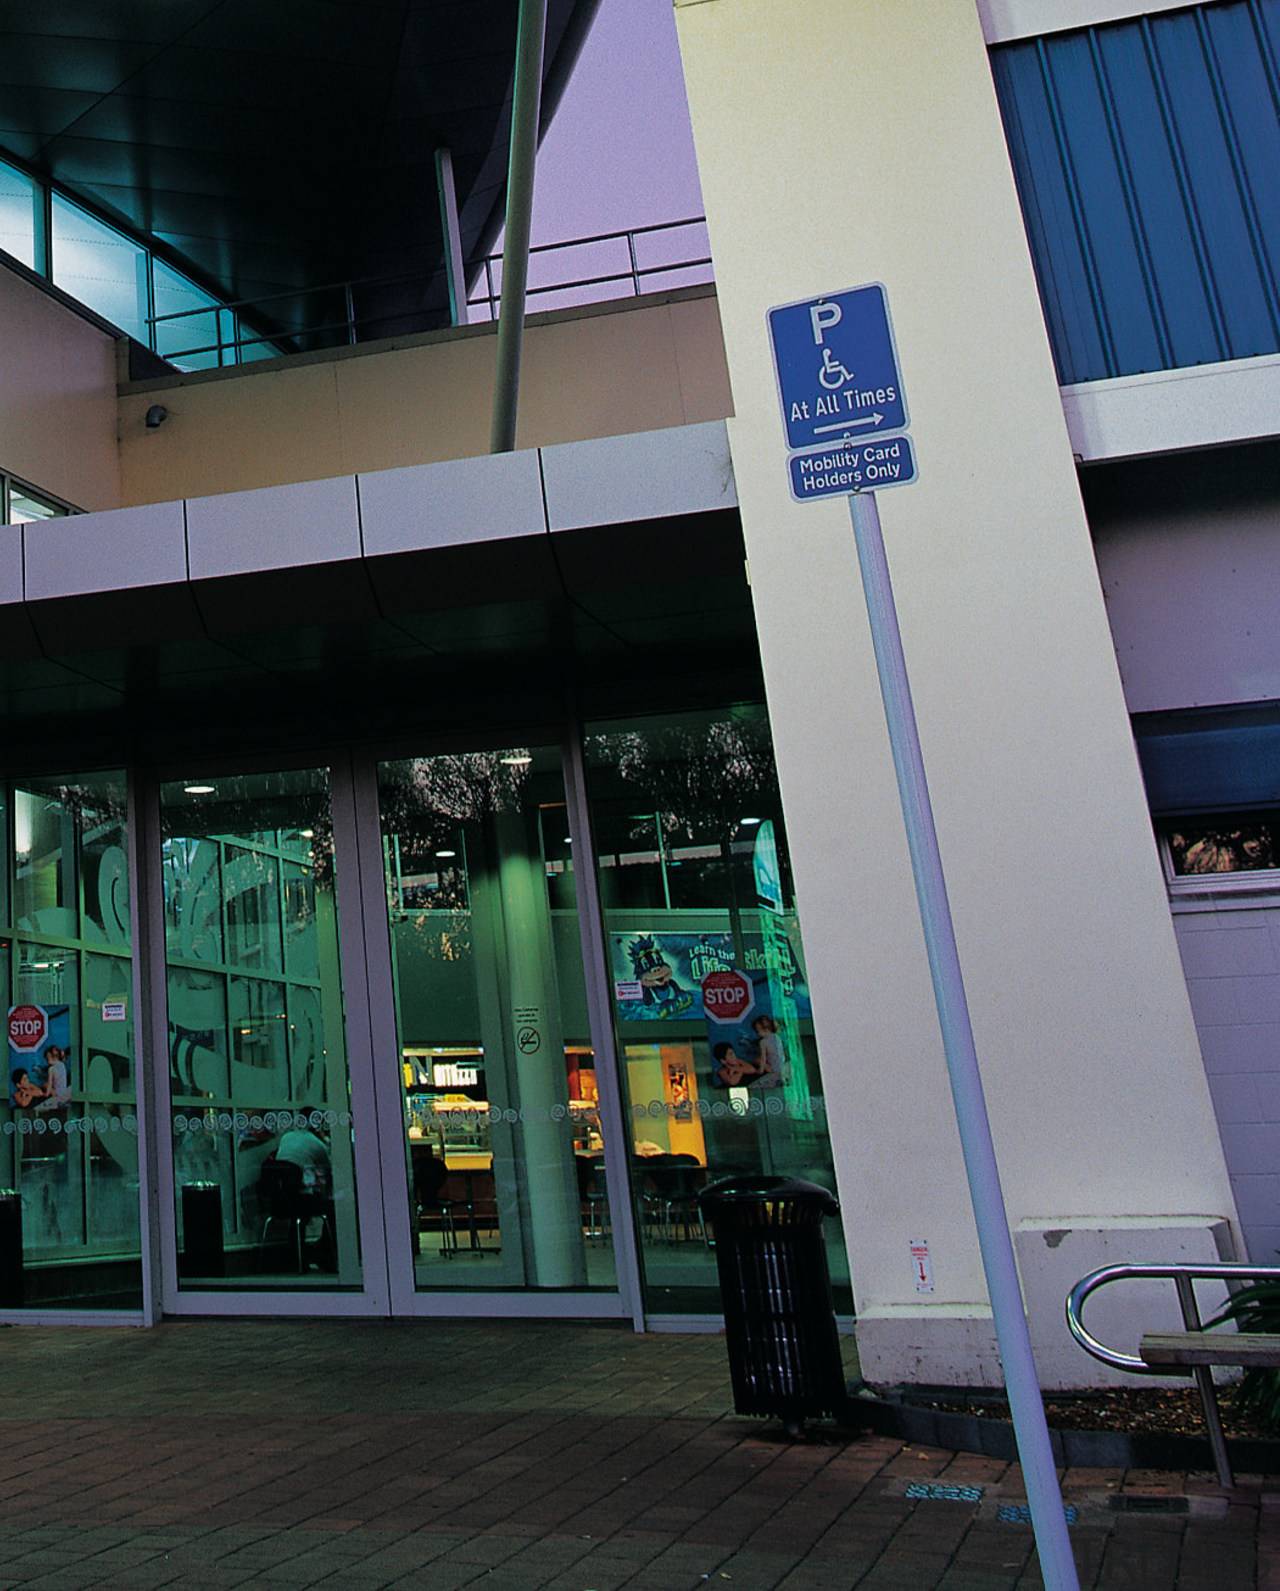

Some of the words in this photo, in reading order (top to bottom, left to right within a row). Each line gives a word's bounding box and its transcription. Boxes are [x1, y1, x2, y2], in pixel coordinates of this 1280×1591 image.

[809, 301, 842, 345] P
[791, 401, 810, 422] At
[816, 394, 840, 417] All
[843, 386, 896, 410] Times
[800, 451, 859, 474] Mobility
[863, 443, 901, 462] Card
[803, 469, 862, 491] Holders
[866, 462, 901, 480] Only
[689, 941, 717, 958] Learn
[717, 949, 736, 961] the
[705, 987, 744, 1004] STOP
[10, 1020, 42, 1036] STOP
